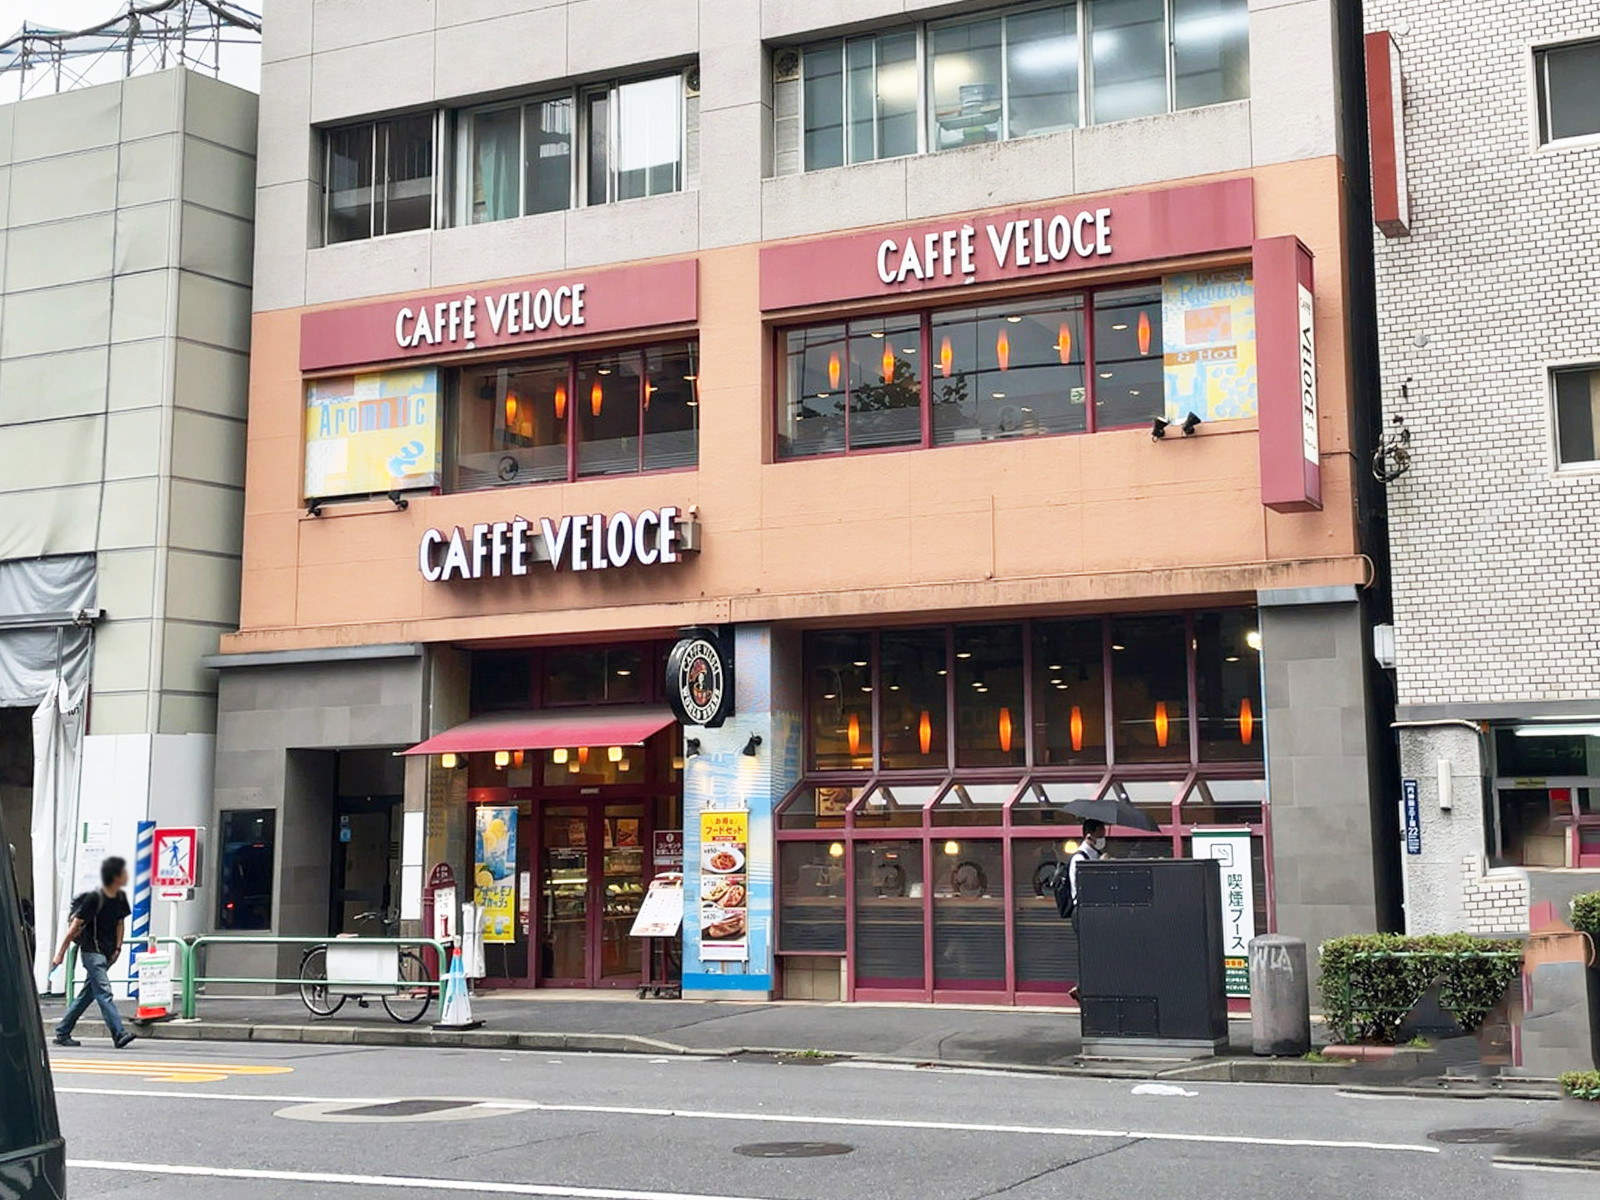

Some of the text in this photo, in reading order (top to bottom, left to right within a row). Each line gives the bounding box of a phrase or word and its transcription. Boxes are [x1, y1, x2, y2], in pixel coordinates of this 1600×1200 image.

[877, 207, 1112, 284] CAFFÈ VELOCE
[395, 283, 585, 348] CAFFÈ VELOCE
[1198, 346, 1237, 361] Hot
[420, 506, 679, 582] CAFFÈ VELOCE
[705, 825, 744, 835] フードセット
[1408, 827, 1418, 836] 22
[1227, 873, 1246, 950] 喫煙ブース
